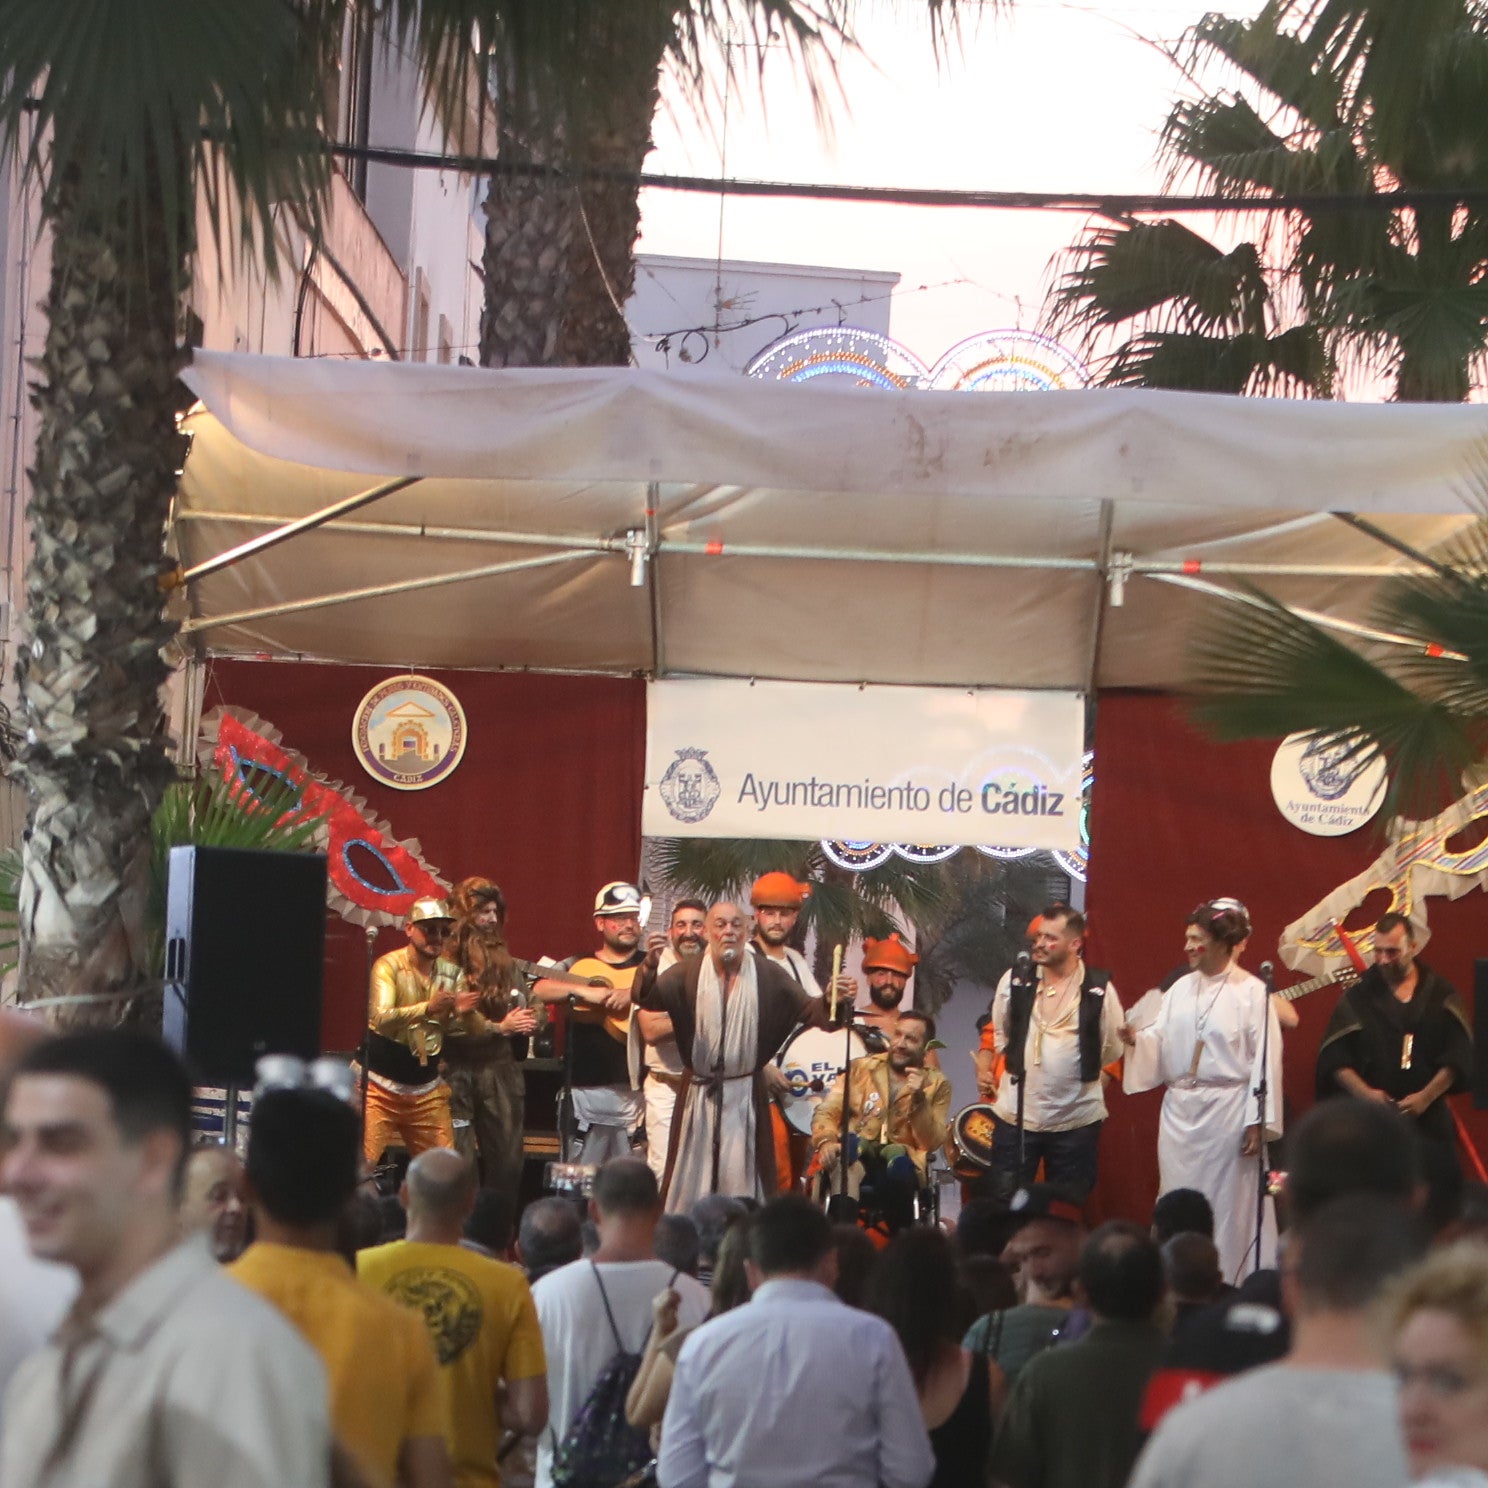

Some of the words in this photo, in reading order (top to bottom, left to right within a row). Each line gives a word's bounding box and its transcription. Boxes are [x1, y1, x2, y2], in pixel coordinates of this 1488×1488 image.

[737, 772, 930, 812] Ayuntamiento
[938, 781, 973, 813] de
[981, 782, 1065, 817] Cádiz
[1300, 813, 1314, 824] de
[811, 1062, 835, 1072] EL
